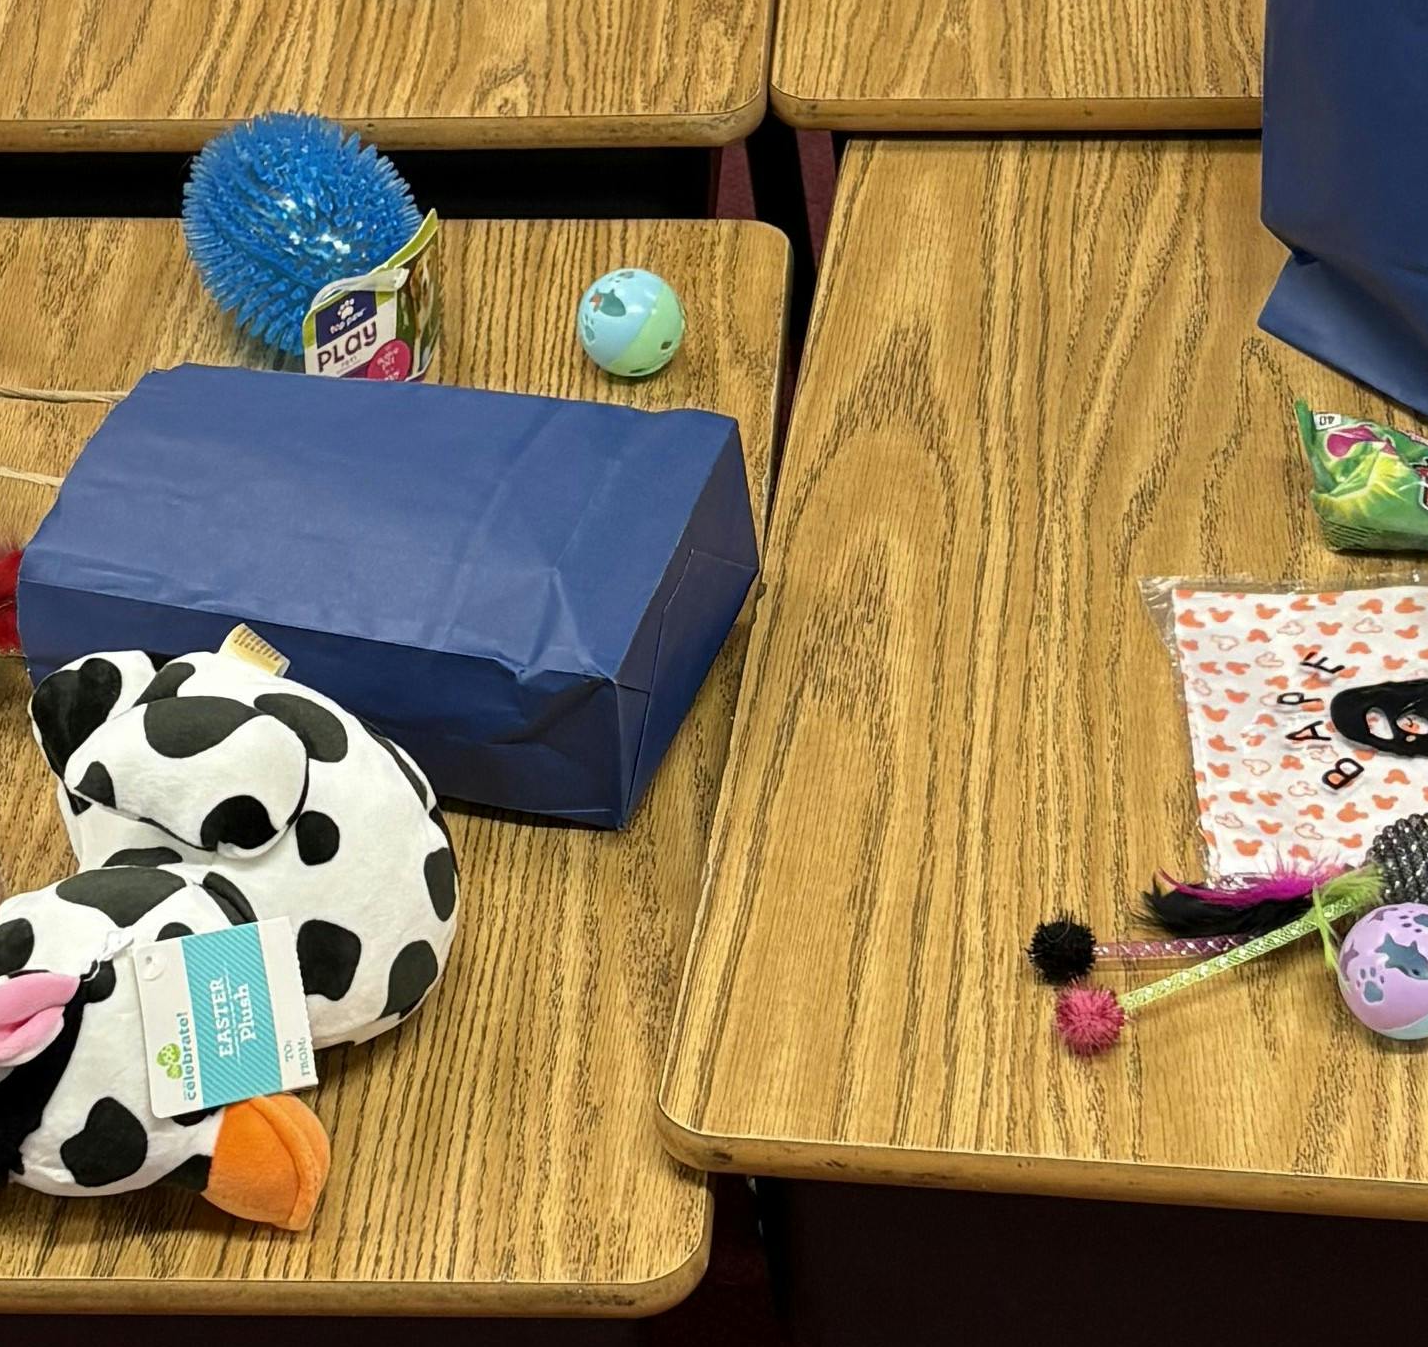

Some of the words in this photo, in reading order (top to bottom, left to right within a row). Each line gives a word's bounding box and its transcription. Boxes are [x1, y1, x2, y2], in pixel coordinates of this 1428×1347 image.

[1275, 651, 1364, 791] BAPE
[210, 976, 233, 1058] EASTER
[234, 983, 256, 1042] Plush
